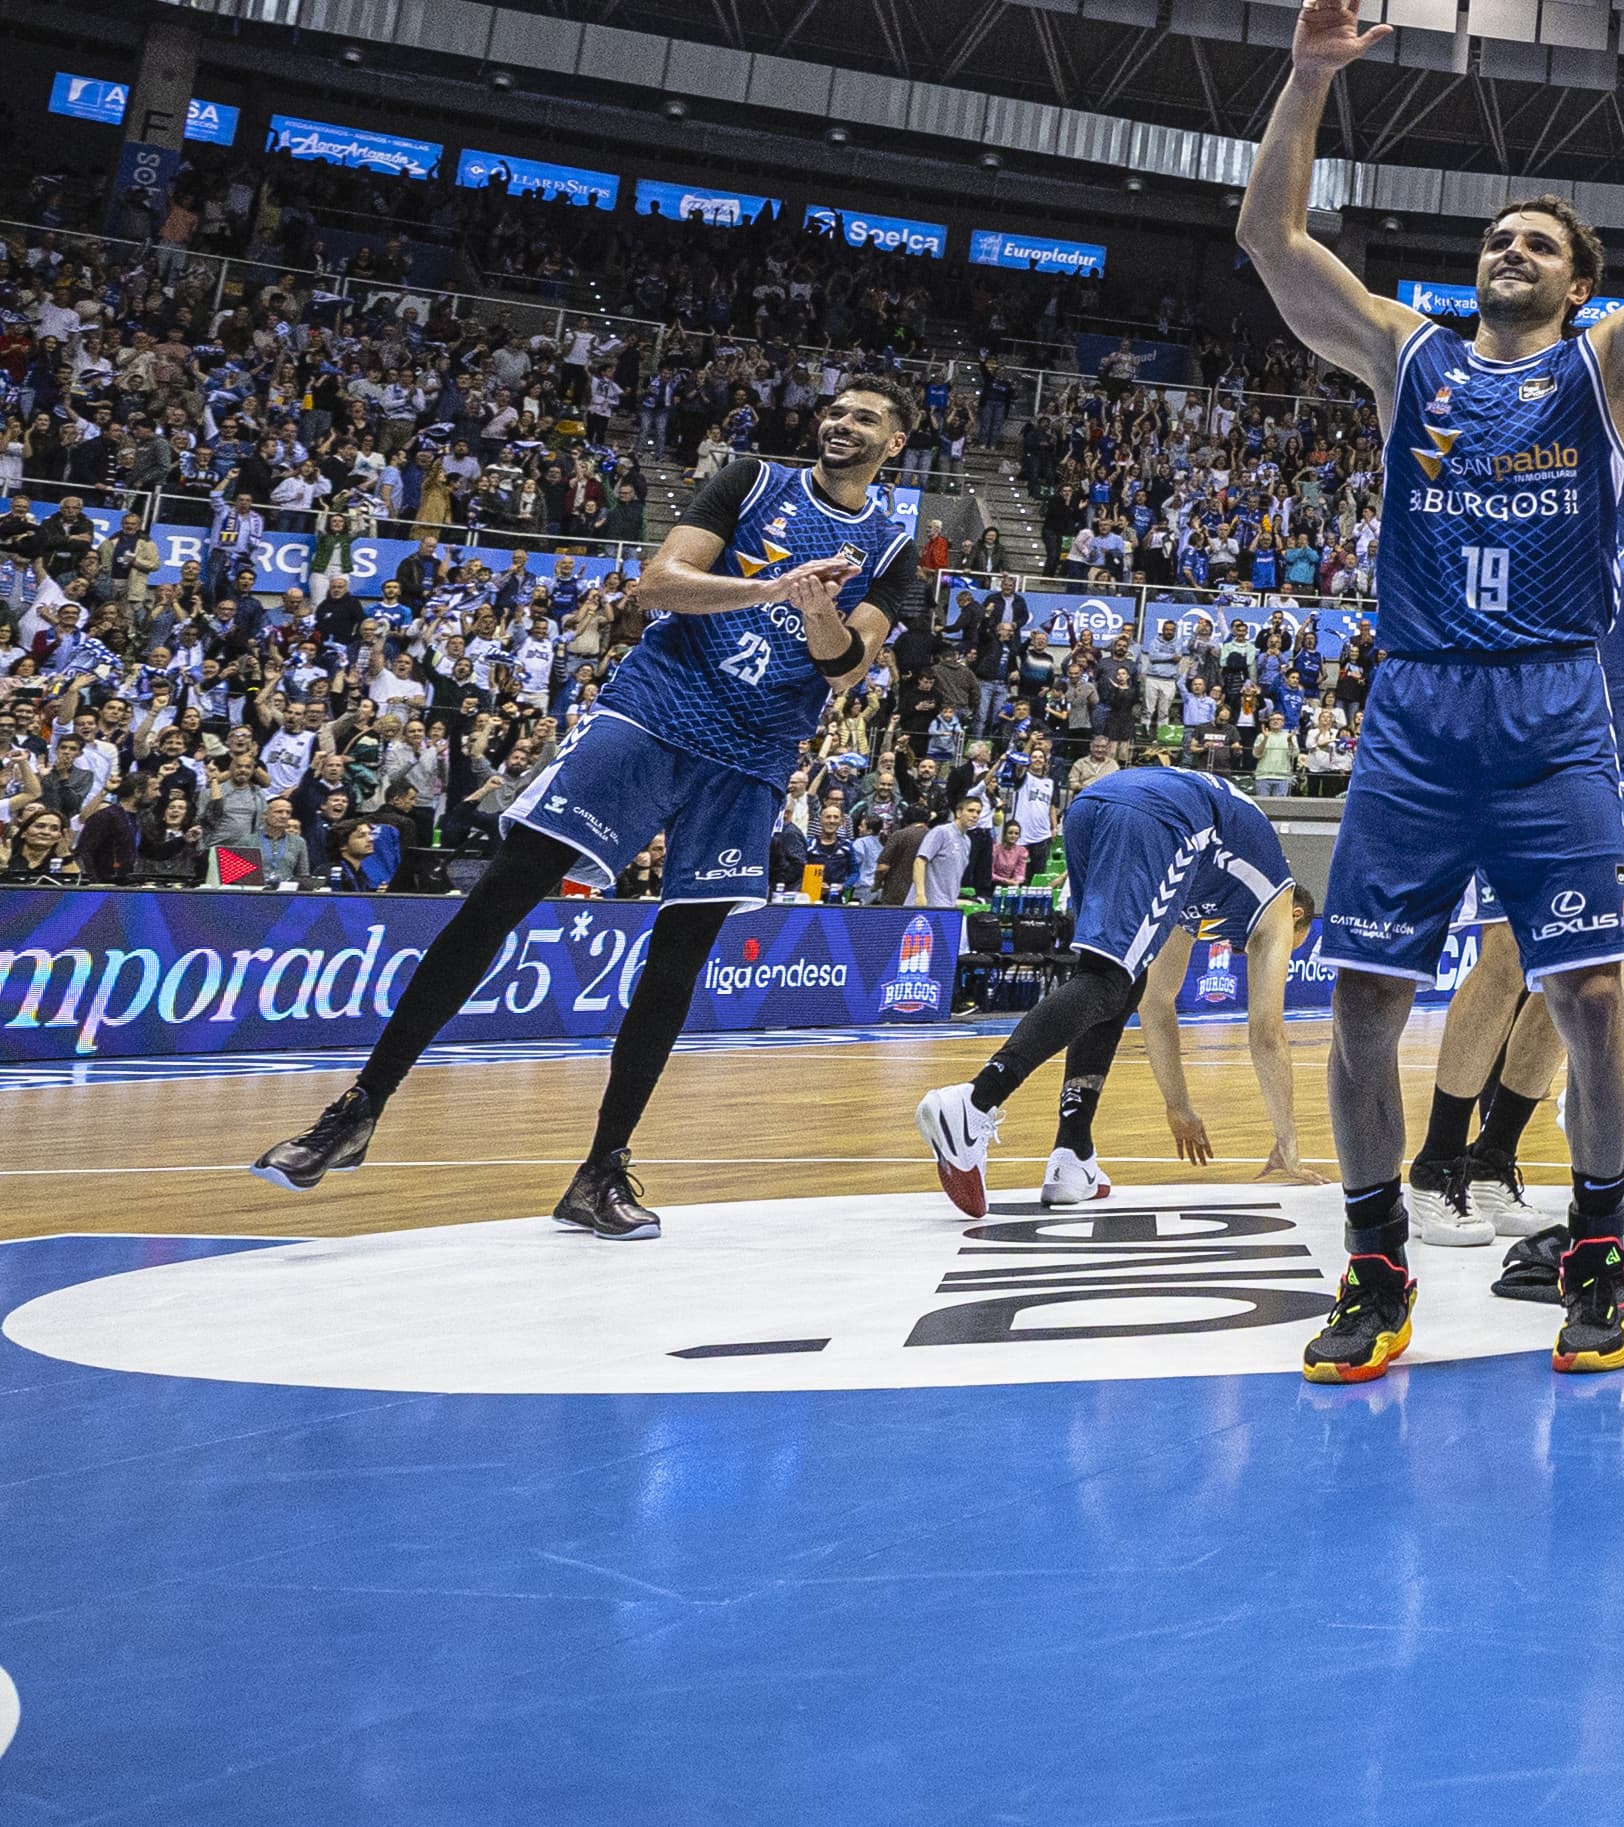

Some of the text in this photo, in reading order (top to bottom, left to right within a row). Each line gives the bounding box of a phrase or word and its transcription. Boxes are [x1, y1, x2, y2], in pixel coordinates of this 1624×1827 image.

[1003, 241, 1097, 268] Europladur
[1422, 487, 1560, 521] BURGOS
[1563, 502, 1579, 514] 31
[1461, 545, 1510, 612] 19
[717, 630, 772, 687] 23
[694, 865, 764, 881] LEXUS
[1330, 914, 1378, 930] CASTILLA
[1383, 921, 1393, 932] Y
[1532, 912, 1620, 942] LEXUS
[705, 958, 848, 995] liga endesa
[884, 981, 938, 1004] BURGOS
